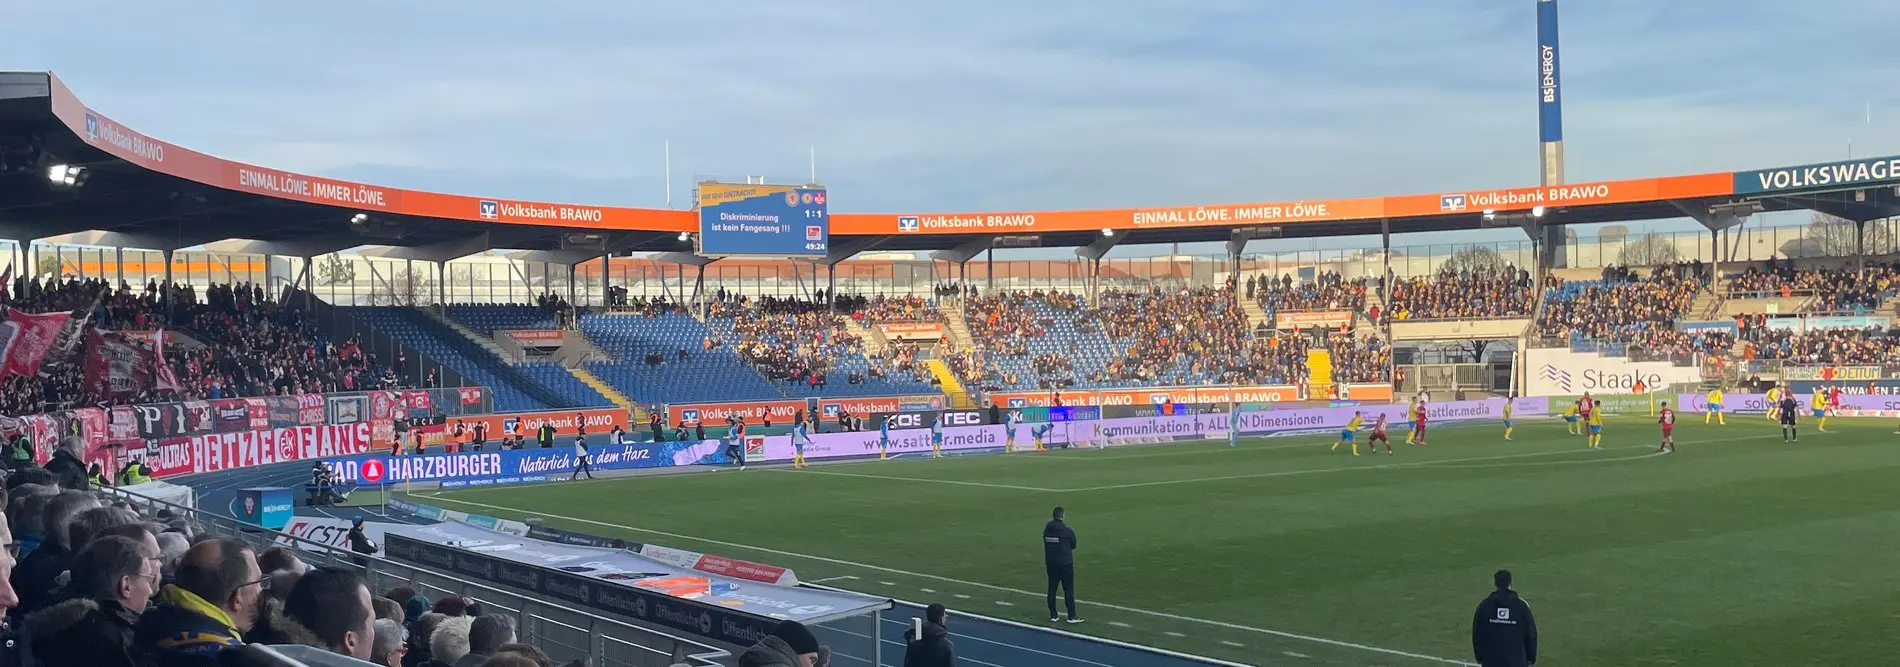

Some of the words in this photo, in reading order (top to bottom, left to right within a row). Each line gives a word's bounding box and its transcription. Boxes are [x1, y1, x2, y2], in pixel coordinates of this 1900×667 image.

[99, 120, 132, 152] Volksbank
[133, 136, 163, 162] BRAWO
[239, 169, 280, 191] EINMAL
[281, 175, 311, 196] LÖWE.
[313, 182, 351, 201] IMMER
[353, 185, 386, 206] LÖWE.
[1469, 189, 1545, 206] Volksbank
[1549, 185, 1609, 201] BRAWO
[500, 203, 557, 219] Volksbank
[560, 207, 602, 222] BRAWO
[720, 212, 779, 223] Diskriminierung
[921, 215, 984, 228] Volksbank
[987, 215, 1035, 226] BRAWO
[1133, 211, 1186, 224] EINMAL
[1189, 207, 1232, 222] LÖWE.
[1234, 207, 1281, 220] IMMER
[1286, 200, 1331, 218] LÖWE.
[711, 223, 721, 231] ist
[723, 223, 739, 231] kein
[740, 224, 780, 234] Fangesang
[1582, 368, 1662, 389] Staake
[843, 403, 897, 413] Volksbank
[1234, 391, 1281, 403] BRAWO
[1093, 419, 1190, 438] Kommunikation
[1208, 414, 1249, 431] ALLN
[1252, 413, 1324, 428] Dimensionen
[301, 422, 371, 458] FANS
[161, 442, 190, 469] ULTRAS
[388, 453, 501, 481] HARZBURGER
[518, 453, 570, 474] Natürlich
[596, 447, 620, 462] dem
[622, 445, 651, 462] Harz.
[655, 603, 700, 628] Öffentliche
[721, 617, 768, 643] Öffentlich
